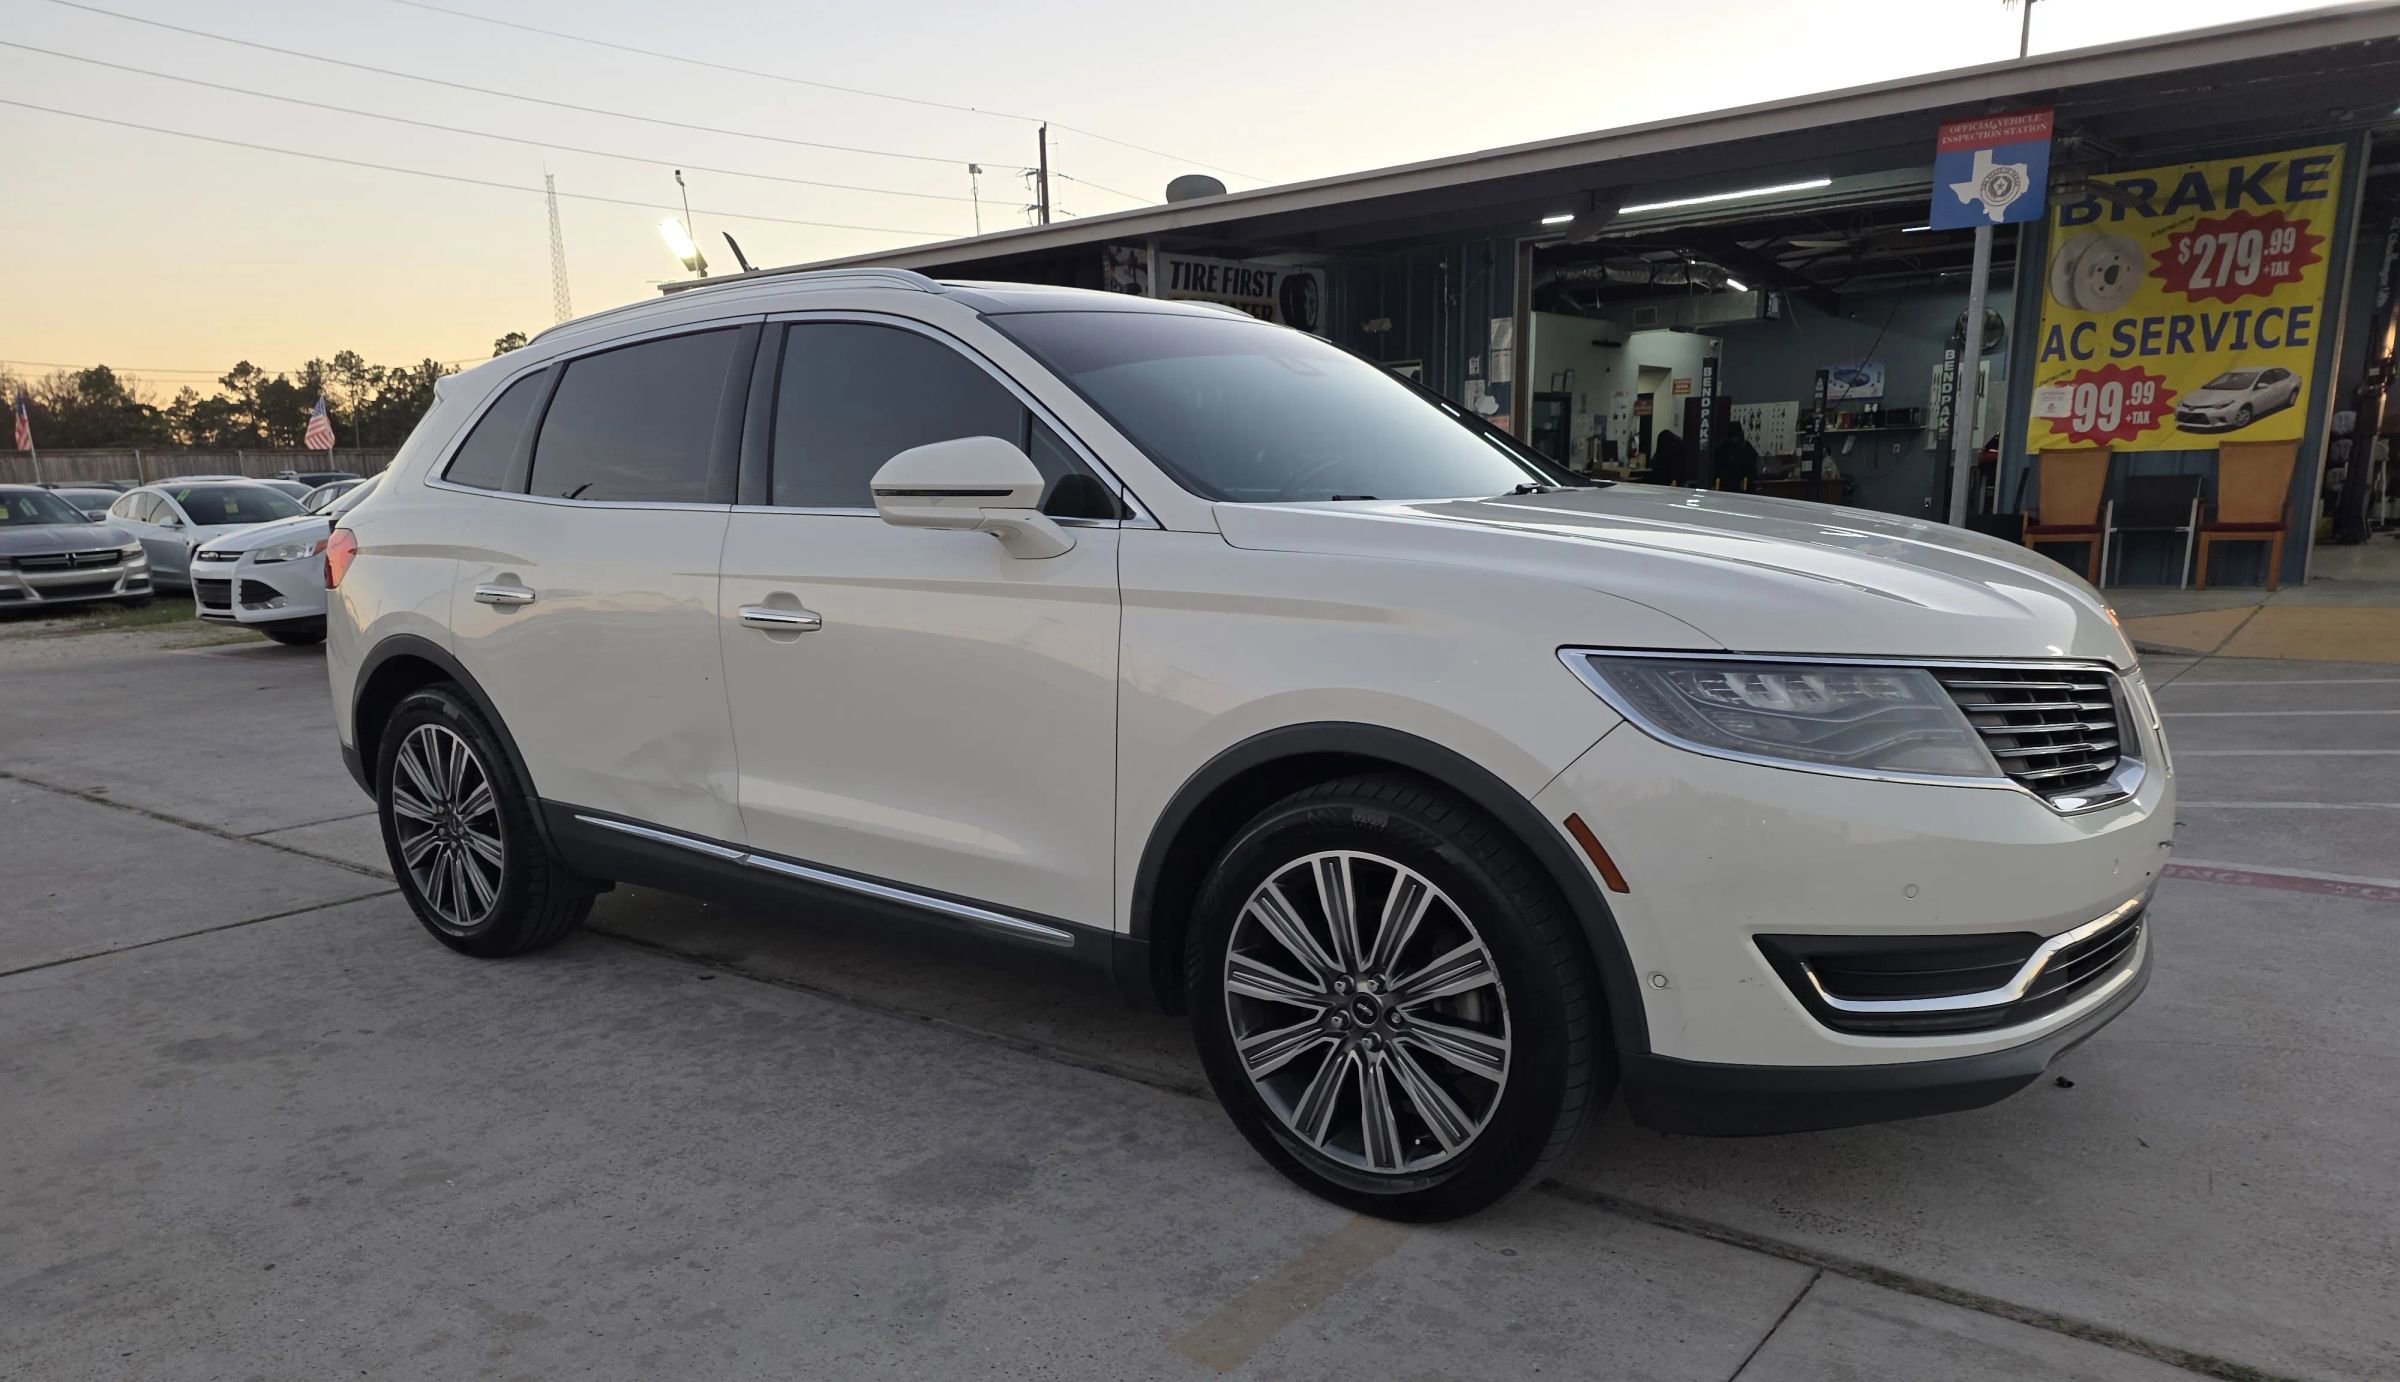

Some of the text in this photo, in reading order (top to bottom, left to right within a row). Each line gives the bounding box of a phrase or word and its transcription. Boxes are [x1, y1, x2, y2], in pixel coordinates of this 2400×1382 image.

[1942, 122, 2048, 144] INSPECTION STATION
[1949, 113, 2042, 133] OFFICIAL VEHICLE
[2059, 154, 2335, 227] BRAKE
[1169, 260, 1219, 293] TIRE
[1222, 266, 1277, 298] FIRST
[2262, 261, 2290, 277] +TAX
[2040, 305, 2314, 363] AC SERVICE
[2124, 410, 2152, 425] +TAX
